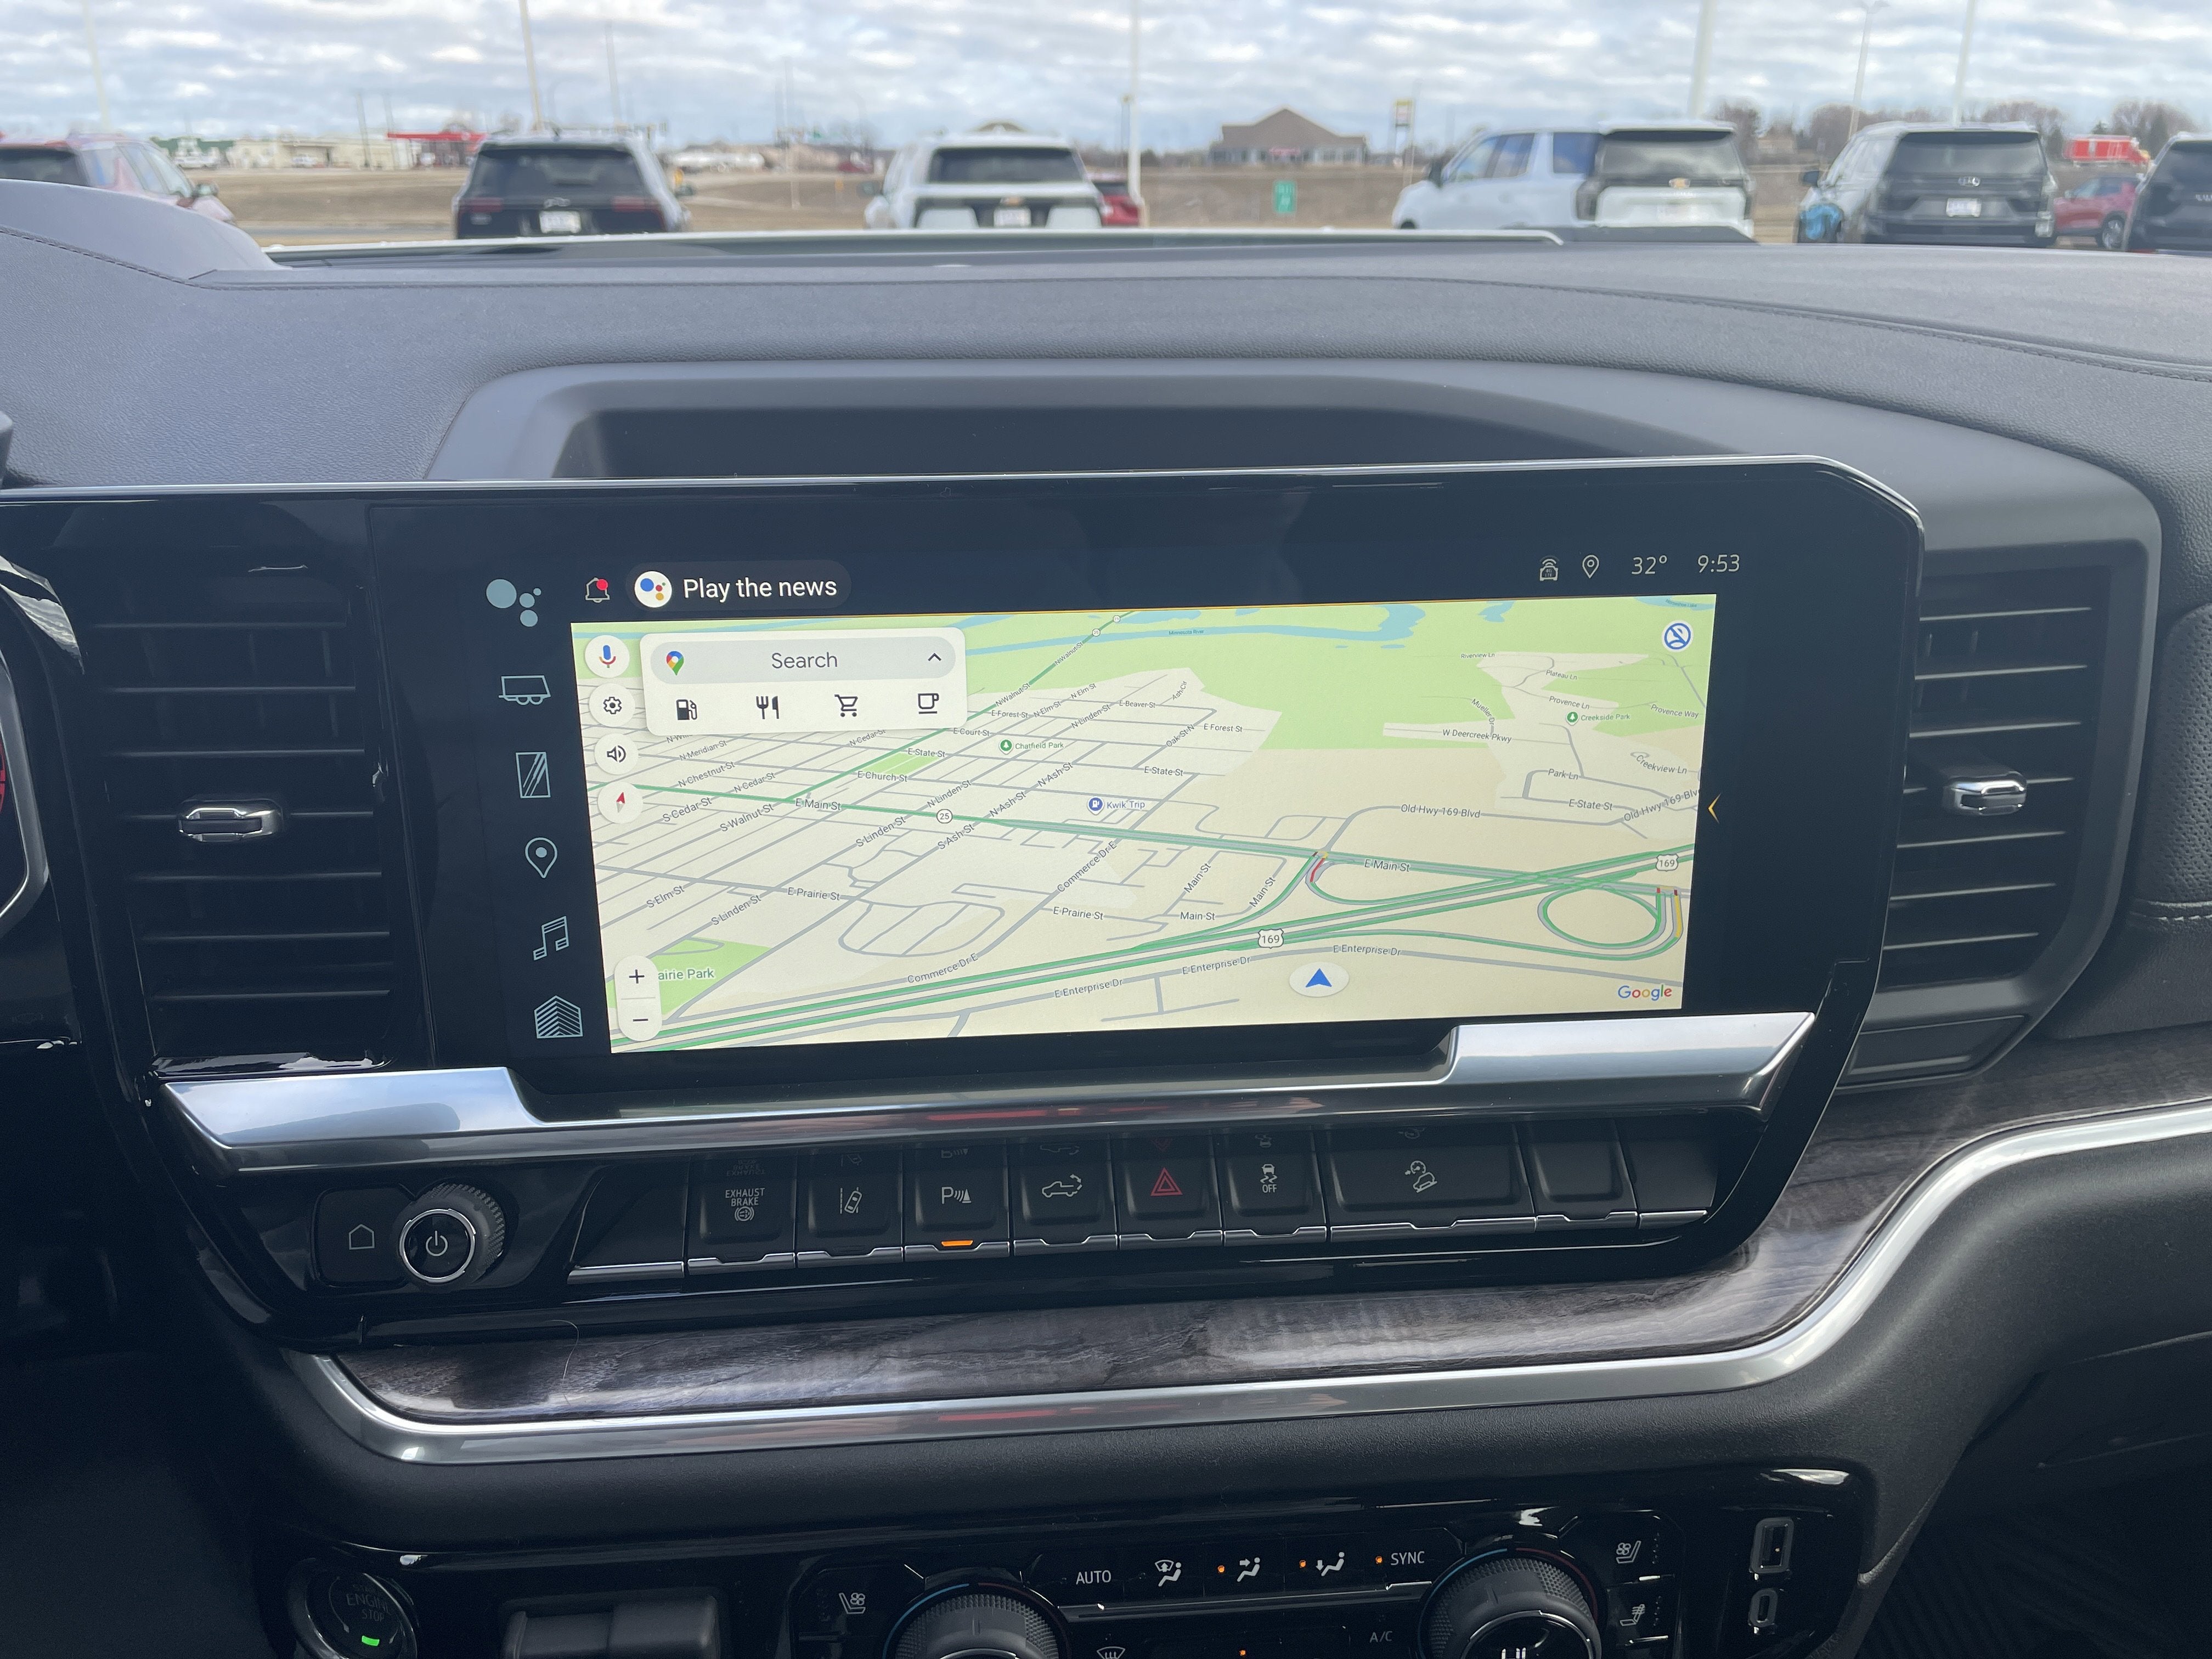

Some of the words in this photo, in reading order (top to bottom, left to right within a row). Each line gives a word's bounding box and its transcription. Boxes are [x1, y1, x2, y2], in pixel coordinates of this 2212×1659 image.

[1697, 554, 1740, 573] 9:53
[683, 578, 730, 603] Play
[736, 577, 772, 597] the
[779, 580, 837, 596] news
[771, 652, 838, 669] Search
[1545, 669, 1569, 679] Plateau
[1002, 687, 1023, 703] Walnut
[1022, 682, 1030, 691] St
[1172, 689, 1183, 701] Ash
[1471, 698, 1492, 716] Mueller
[1549, 696, 1580, 708] Provence
[1071, 720, 1079, 729] N
[1079, 709, 1102, 725] Linden
[1102, 704, 1110, 713] St
[1651, 704, 1682, 716] Provence
[1685, 710, 1699, 719] Way
[1166, 736, 1180, 747] Oak
[1180, 729, 1189, 738] St
[1188, 724, 1195, 732] N
[1210, 724, 1233, 732] Forest
[1452, 730, 1490, 740] Deercreek
[1492, 733, 1512, 744] Pkwy
[913, 748, 936, 757] State
[1152, 767, 1173, 776] State
[1636, 754, 1675, 774] Creekview
[1677, 766, 1687, 774] Ln
[686, 765, 724, 783] Chestnut
[725, 761, 735, 769] St
[865, 771, 897, 781] Church
[899, 774, 907, 782] St
[1037, 778, 1047, 787] N
[1047, 769, 1062, 782] Ash
[1063, 762, 1074, 772] St
[1548, 769, 1566, 778] Park
[1568, 771, 1578, 780] Ln
[742, 776, 766, 790] Cedar
[766, 771, 776, 780] St
[927, 799, 936, 808] N
[935, 785, 962, 804] Linden
[962, 779, 972, 789] St
[662, 813, 670, 822] S
[671, 802, 699, 819] Cedar
[701, 797, 712, 807] St
[795, 798, 803, 806] E
[805, 799, 829, 809] Main
[831, 802, 841, 810] St
[989, 808, 999, 817] N
[999, 798, 1015, 813] Ash
[1015, 791, 1026, 801] St
[1107, 800, 1126, 809] Kwik
[1129, 800, 1145, 810] Trip
[1401, 804, 1417, 812] Old
[1419, 805, 1439, 817] Hwy
[1442, 807, 1459, 816] 169
[1461, 808, 1481, 819] Blvd
[1568, 799, 1575, 807] E
[1577, 799, 1601, 809] State
[1603, 802, 1613, 811] St
[1624, 809, 1639, 822] Old
[1641, 802, 1661, 816] Hwy
[1664, 794, 1681, 806] 169
[1684, 789, 1700, 799] Blv
[720, 823, 727, 832] S
[728, 808, 762, 828] Walnut
[763, 803, 774, 812] St
[856, 838, 864, 848] S
[864, 822, 895, 843] Linden
[895, 816, 906, 827] St
[938, 840, 946, 850] S
[945, 831, 963, 847] Ash
[963, 823, 975, 834] St
[1057, 855, 1100, 893] Commerce
[1098, 848, 1110, 859] Dr
[1109, 840, 1117, 850] E
[1364, 859, 1370, 868] E
[1373, 860, 1398, 871] Main
[1400, 862, 1410, 872] St
[1660, 859, 1675, 867] 169
[1184, 872, 1204, 893] Main
[1200, 862, 1211, 874] St
[646, 900, 654, 909] S
[654, 890, 673, 906] Elm
[673, 885, 685, 895] St
[787, 887, 794, 895] E
[797, 888, 828, 900] Prairie
[830, 891, 840, 901] St
[1249, 887, 1268, 908] Main
[1265, 876, 1276, 889] St
[711, 916, 719, 926] S
[719, 902, 750, 922] Linden
[751, 894, 761, 905] St
[1062, 907, 1092, 919] Prairie
[1094, 911, 1103, 921] St
[1180, 911, 1203, 921] Main
[1205, 912, 1215, 921] St
[1262, 934, 1279, 944] 169
[1333, 945, 1339, 953] E
[1341, 944, 1389, 956] Enterprise
[1391, 947, 1401, 956] Dr
[907, 963, 958, 983] Commerce
[958, 958, 970, 967] Dr
[970, 952, 978, 961] E
[1182, 966, 1189, 975] E
[1190, 958, 1238, 974] Enterprise
[1240, 956, 1251, 965] Dr
[658, 969, 684, 980] airie
[687, 968, 714, 979] Park
[1054, 990, 1061, 998] E
[1063, 981, 1110, 997] Enterprise
[1111, 978, 1122, 988] Dr
[1618, 984, 1672, 1001] Google
[725, 1187, 765, 1198] EXHAUST
[1262, 1184, 1277, 1193] OFF
[731, 1197, 759, 1207] BRAKE
[1391, 1551, 1425, 1566] SYNC
[1076, 1570, 1111, 1585] AUTO
[1370, 1631, 1392, 1644] A/C
